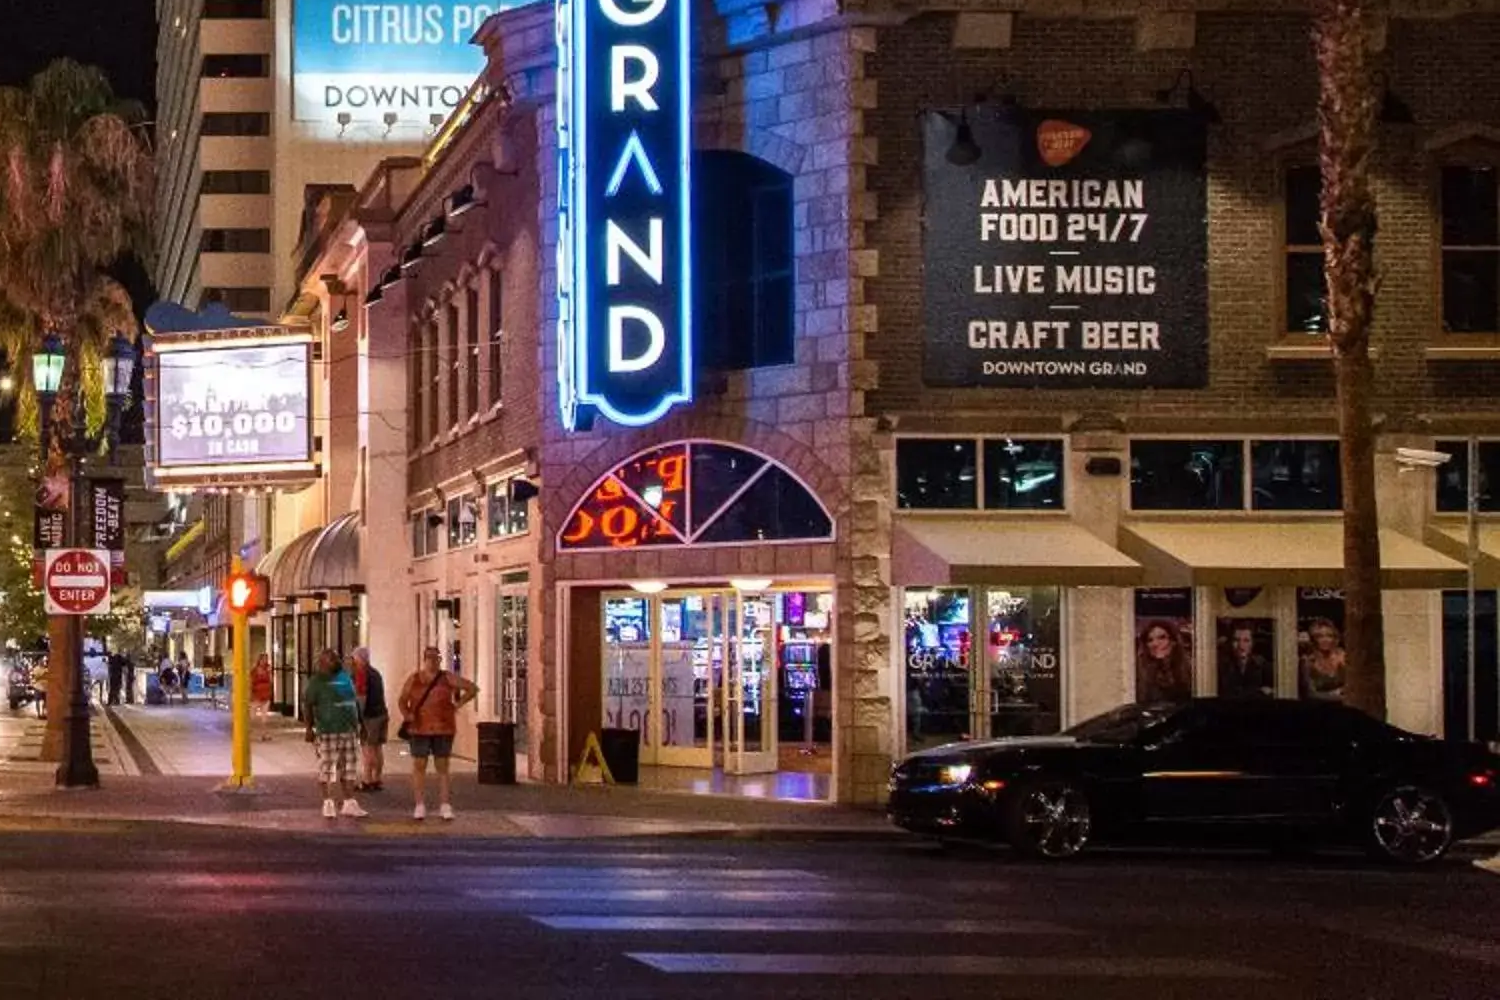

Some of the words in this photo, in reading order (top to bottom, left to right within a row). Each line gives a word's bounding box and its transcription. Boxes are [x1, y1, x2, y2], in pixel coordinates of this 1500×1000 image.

[332, 4, 443, 45] CITRUS
[324, 85, 469, 108] DOWNTO
[980, 179, 1144, 209] AMERICAN
[980, 213, 1059, 242] FOOD
[1066, 213, 1149, 243] 24/7
[973, 265, 1046, 294] LIVE
[1055, 265, 1157, 295] MUSIC
[967, 320, 1071, 350] CRAFT
[1080, 320, 1162, 350] BEER
[982, 360, 1086, 377] DOWNTOWN
[1088, 360, 1148, 376] GRAND
[171, 411, 296, 441] $10,000
[94, 486, 108, 550] FREEDOM
[107, 495, 121, 528] BEAT
[38, 516, 51, 542] LIVE
[51, 512, 64, 548] MUSIC
[54, 562, 72, 575] DO
[77, 562, 101, 575] NOT
[58, 589, 96, 602] ENTER
